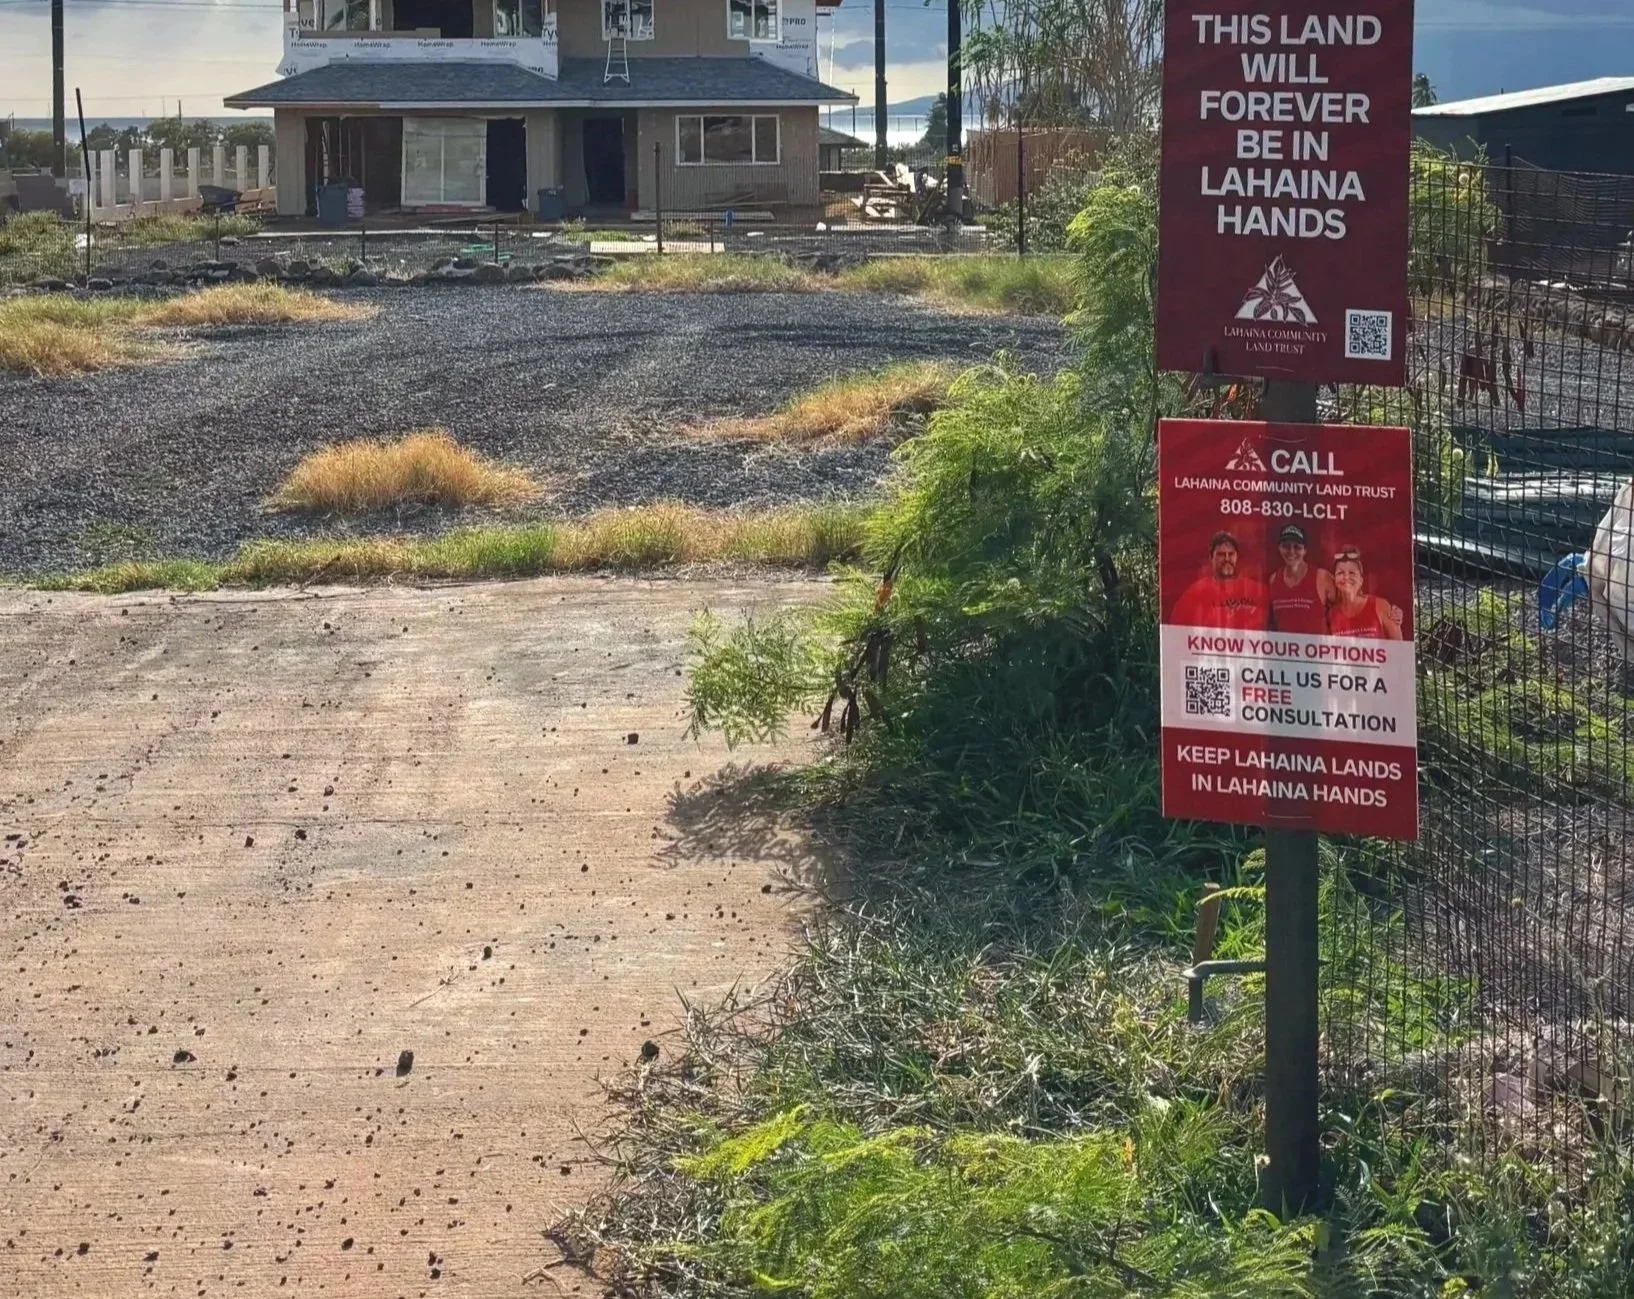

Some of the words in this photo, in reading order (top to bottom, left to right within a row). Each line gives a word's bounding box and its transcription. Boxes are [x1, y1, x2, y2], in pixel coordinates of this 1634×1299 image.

[1192, 14, 1272, 44] THIS
[1280, 14, 1382, 46] LAND
[1241, 52, 1329, 84] WILL
[1200, 90, 1370, 124] FOREVER
[1237, 129, 1283, 160] BE
[1292, 131, 1328, 161] IN
[1201, 166, 1366, 201] LAHAINA
[1217, 204, 1347, 240] HANDS
[1224, 326, 1267, 340] LAHAINA
[1268, 328, 1328, 343] COMMUNITY
[1246, 342, 1272, 353] LAND
[1273, 344, 1306, 356] TRUST
[1271, 449, 1344, 476] CALL
[1174, 476, 1231, 491] LAHAINA
[1233, 479, 1315, 496] COMMUNITY
[1316, 484, 1352, 496] LAND
[1353, 485, 1396, 498] TRUST
[1220, 498, 1348, 521] 808-830-LCLT
[1187, 635, 1244, 653] KNOW
[1248, 639, 1300, 657] YOUR
[1305, 643, 1387, 663] OPTIONS
[1241, 667, 1291, 686] CALL
[1296, 671, 1322, 689] US
[1328, 674, 1368, 692] FOR
[1373, 677, 1388, 694] A
[1242, 687, 1292, 705] FREE
[1241, 705, 1397, 732] CONSULTATION
[1177, 744, 1231, 765] KEEP
[1234, 749, 1327, 773] LAHAINA
[1331, 759, 1402, 780] LANDS
[1191, 773, 1212, 791] IN
[1216, 775, 1308, 800] LAHAINA
[1313, 785, 1388, 808] HANDS
